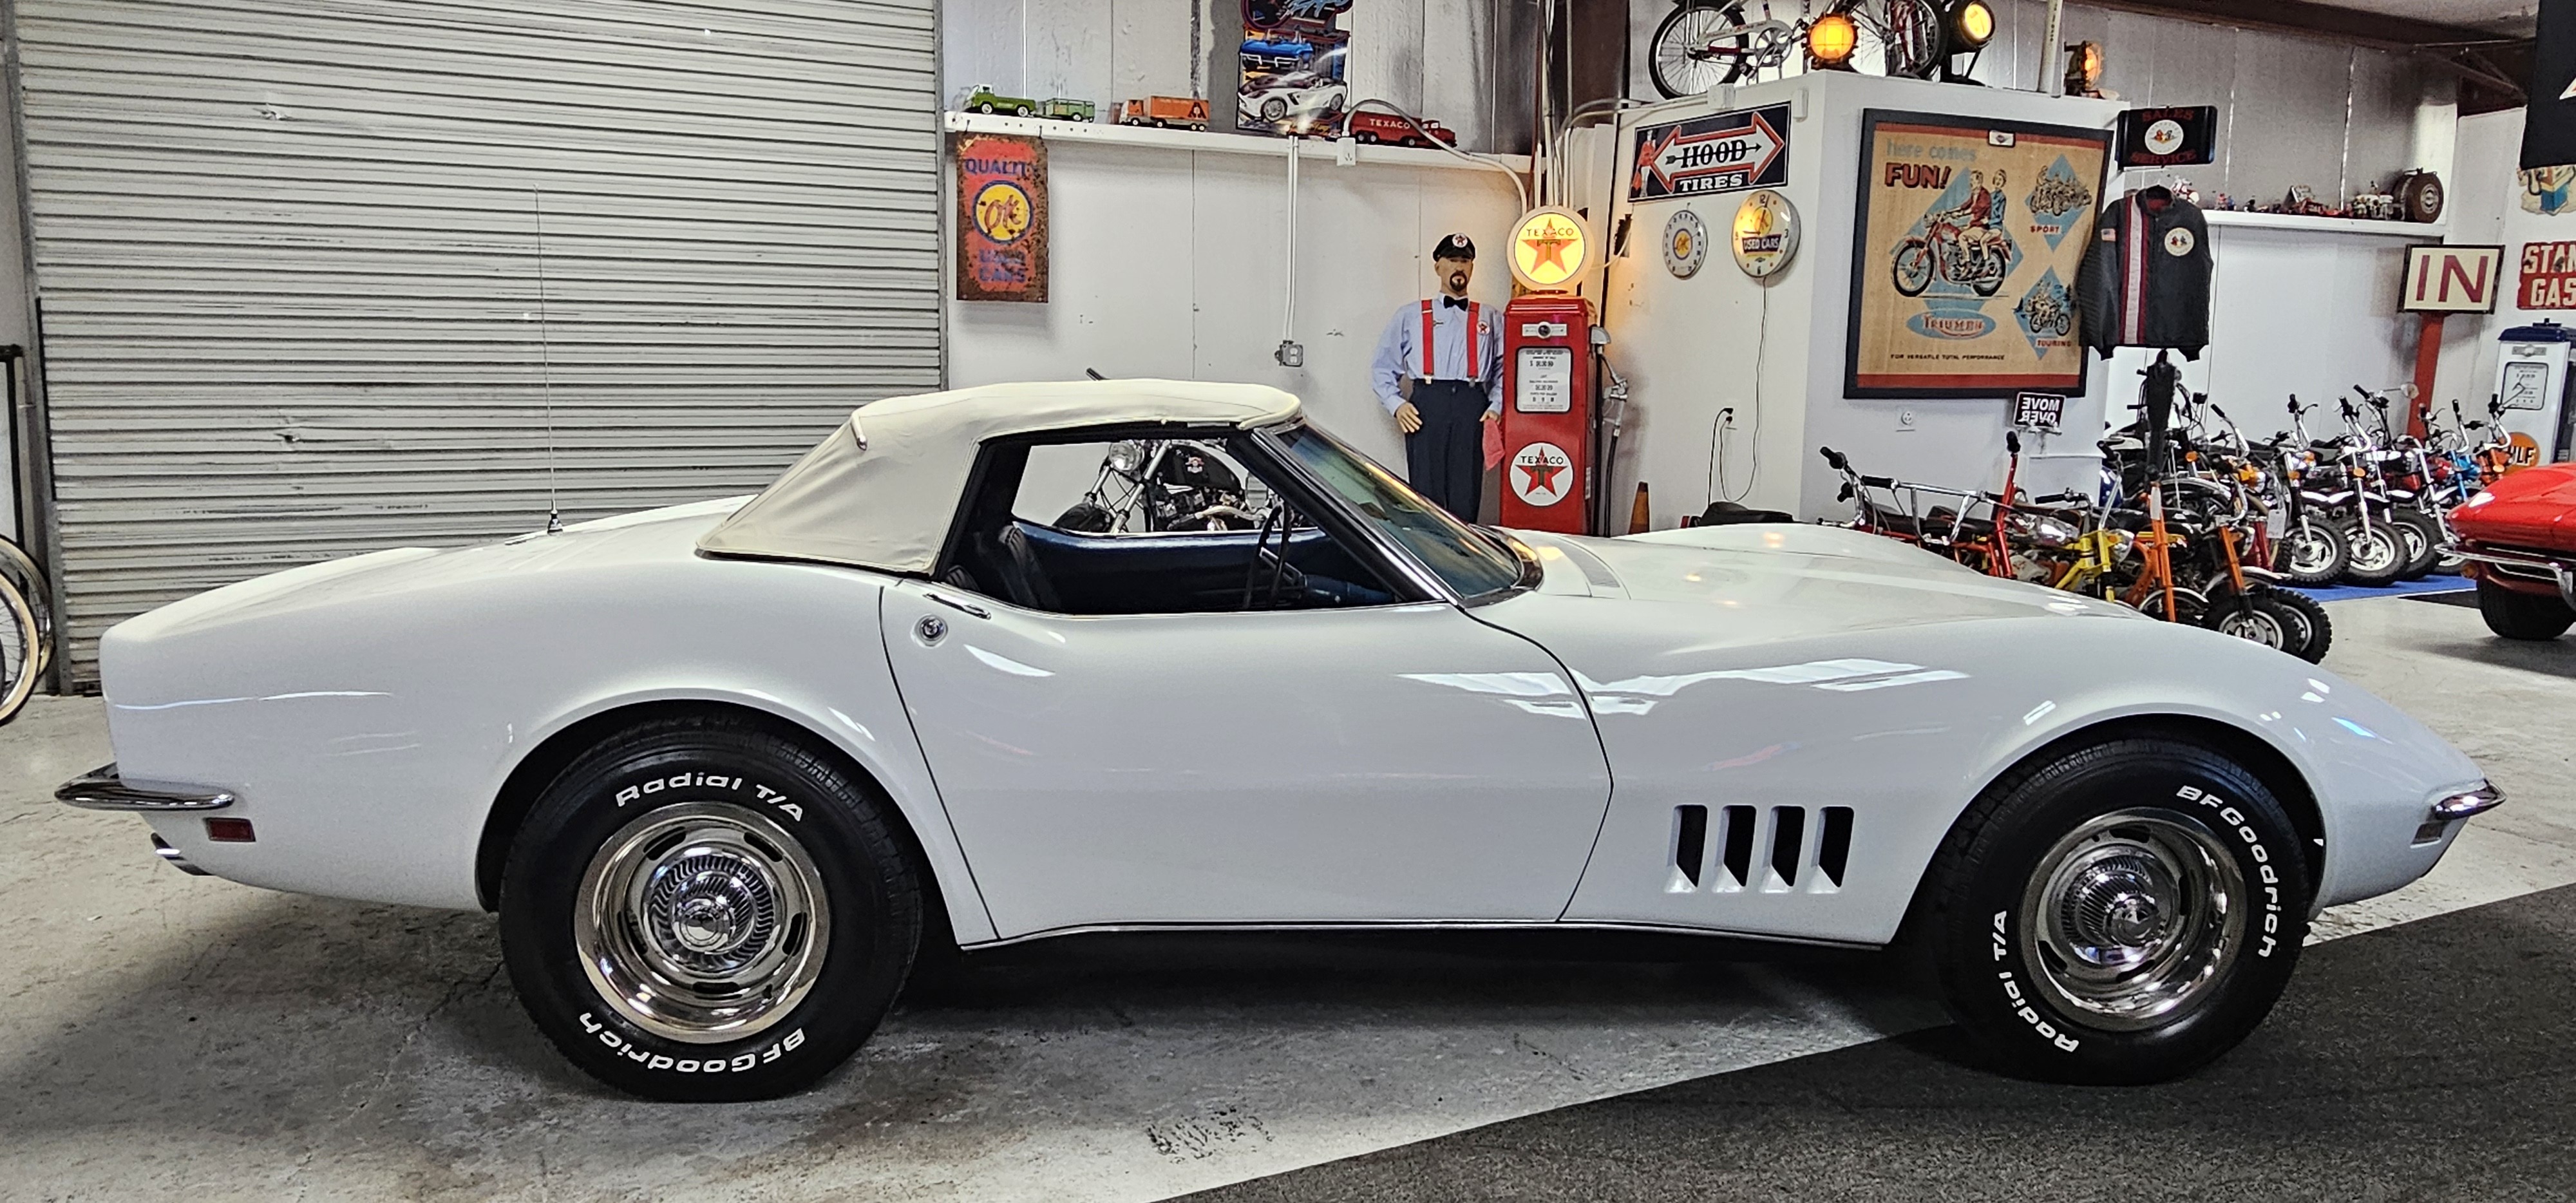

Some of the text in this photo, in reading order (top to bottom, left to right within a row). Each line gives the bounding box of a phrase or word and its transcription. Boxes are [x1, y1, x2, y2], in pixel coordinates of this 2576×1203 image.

[1369, 118, 1411, 129] TEXACO
[2142, 108, 2195, 122] SALES
[1681, 139, 1747, 168] HOOD
[1887, 137, 1976, 161] here comes
[2130, 149, 2197, 164] SERVICE
[1680, 174, 1743, 191] TIRES
[1884, 162, 1952, 189] FUN!
[1526, 227, 1574, 236] TEXACO
[1744, 238, 1779, 250] USED CARS
[2416, 255, 2489, 303] IN
[1520, 455, 1564, 465] TEXACO
[615, 772, 804, 822] Radial T/A
[2176, 785, 2282, 958] BFGoodrich
[1993, 910, 2079, 1052] Radial T/A
[579, 1012, 806, 1073] BFGoodrich
